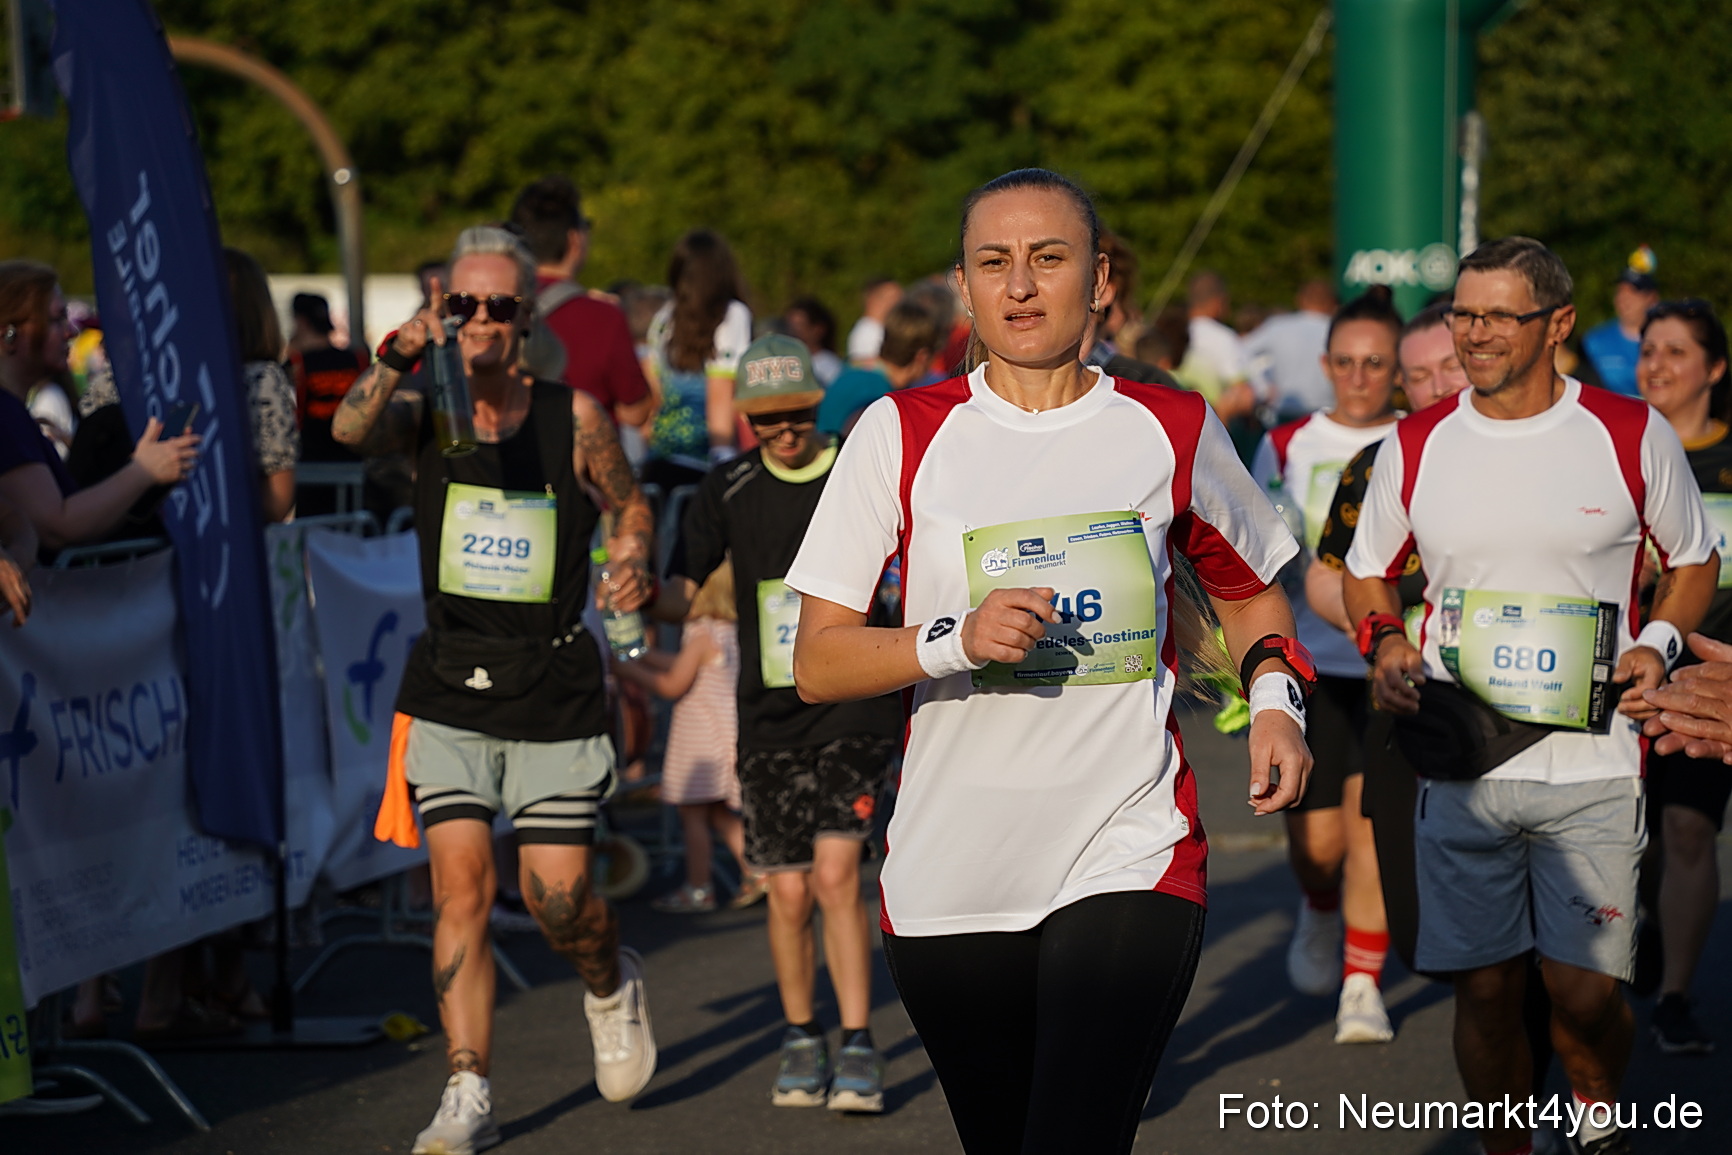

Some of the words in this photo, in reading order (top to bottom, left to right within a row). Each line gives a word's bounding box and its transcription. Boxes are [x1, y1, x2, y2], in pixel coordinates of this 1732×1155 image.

[1343, 249, 1421, 287] AOK
[745, 356, 803, 388] NYC
[463, 533, 531, 559] 2299
[1012, 550, 1066, 567] Firmenlauf
[1034, 560, 1066, 570] neumarkt
[1036, 629, 1156, 650] edeles-Gostinar
[1493, 645, 1556, 673] 680
[1489, 677, 1528, 689] Roland
[1531, 680, 1563, 692] Wolff
